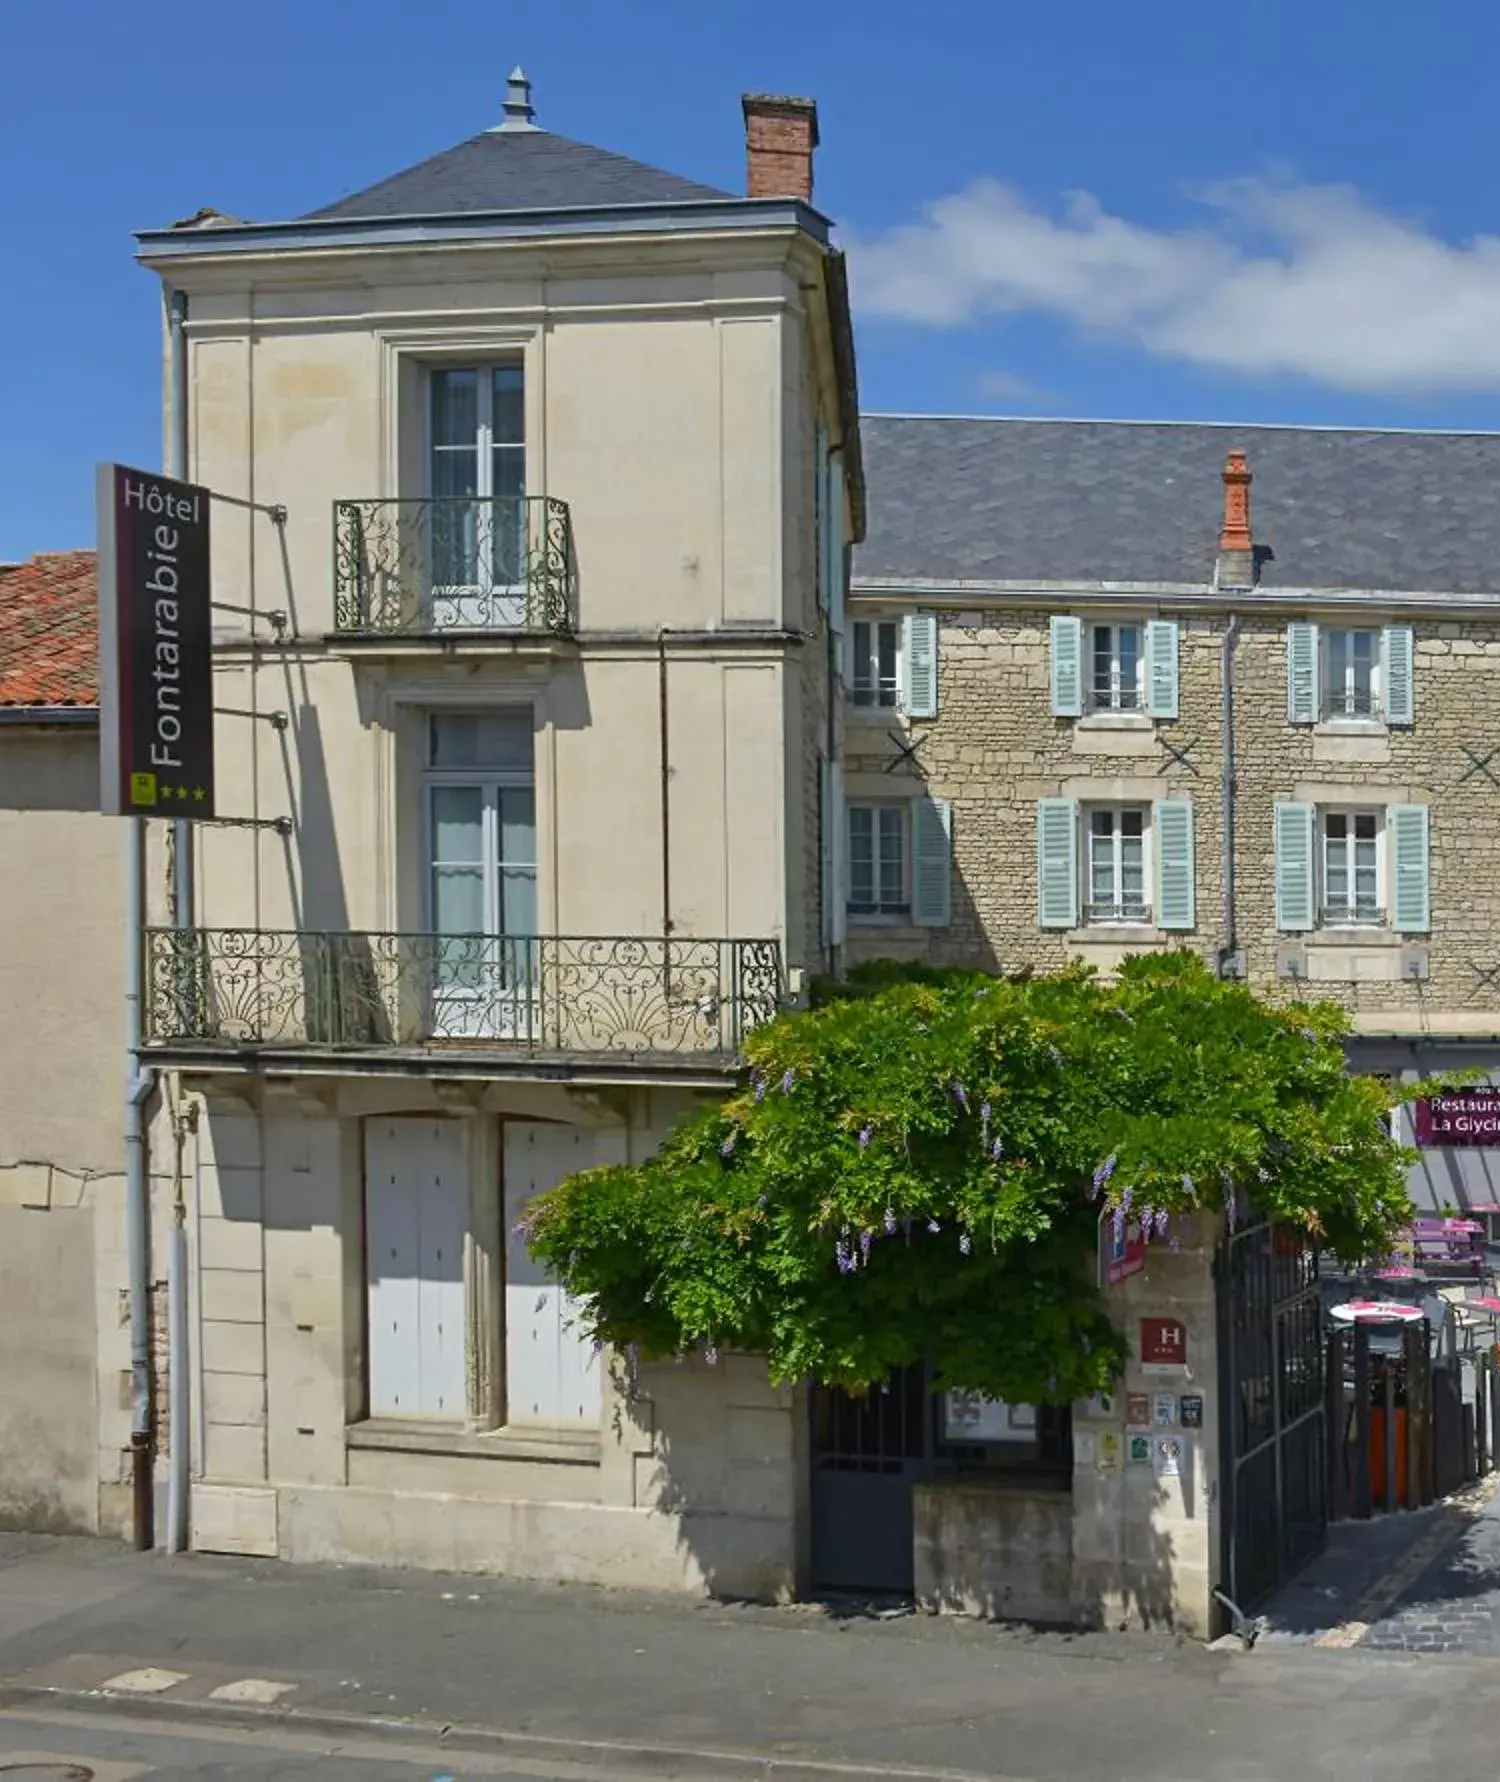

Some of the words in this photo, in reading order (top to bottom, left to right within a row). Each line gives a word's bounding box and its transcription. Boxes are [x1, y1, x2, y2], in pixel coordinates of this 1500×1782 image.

[125, 478, 199, 524] Hôtel
[145, 525, 182, 768] Fontarabie
[1431, 1117, 1451, 1131] La
[1161, 1327, 1180, 1345] H
